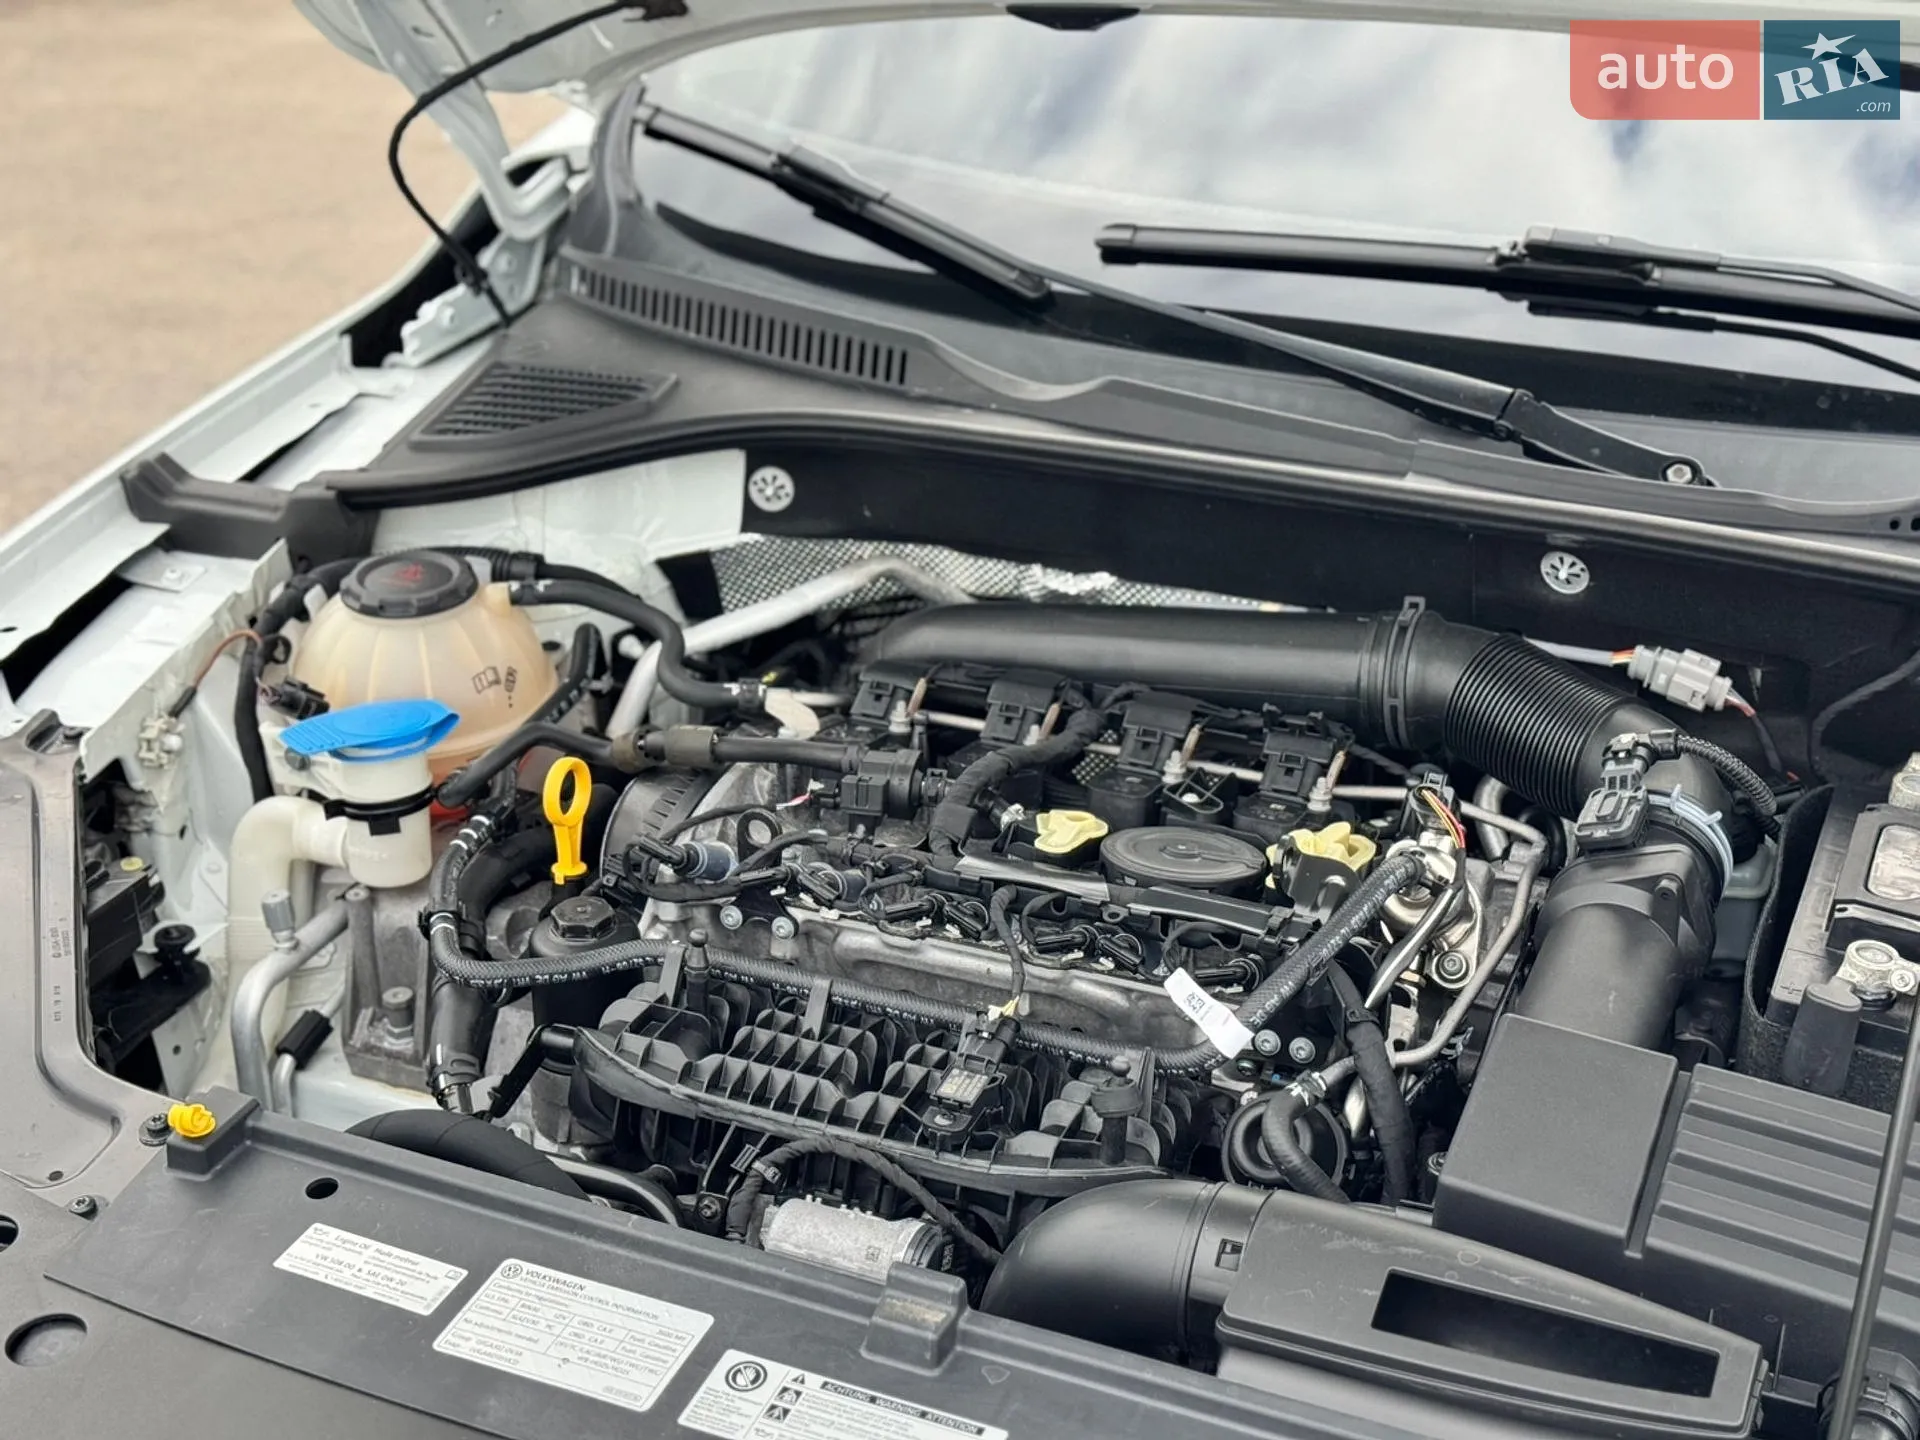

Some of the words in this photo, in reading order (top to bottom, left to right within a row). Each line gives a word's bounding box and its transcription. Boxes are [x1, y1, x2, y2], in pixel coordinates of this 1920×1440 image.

[525, 1268, 587, 1292] VOLKSWAGEN
[824, 1382, 873, 1403] ACHTUNG
[874, 1396, 922, 1417] WARNING
[925, 1410, 979, 1435] ATTENTION
